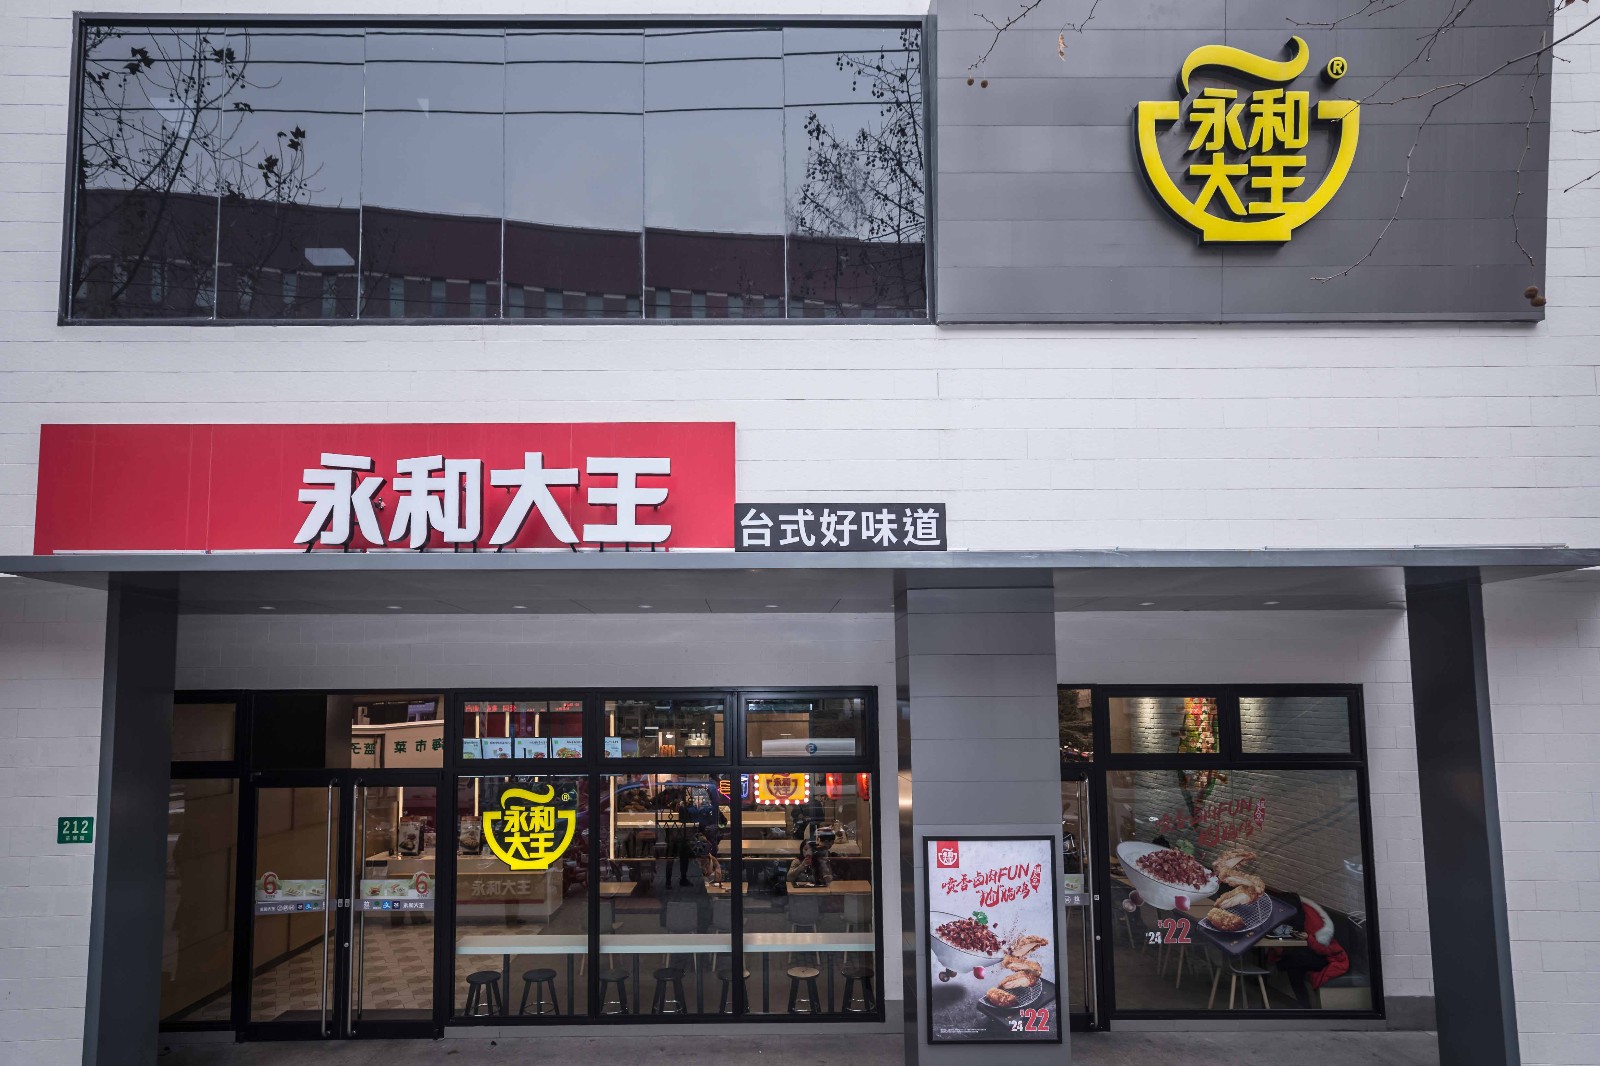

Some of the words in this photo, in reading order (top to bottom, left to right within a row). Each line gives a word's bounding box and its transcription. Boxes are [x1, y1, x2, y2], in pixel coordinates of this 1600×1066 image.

[1188, 87, 1310, 152] 永和
[1188, 152, 1307, 216] 大王
[293, 451, 672, 544] 永和大王
[739, 507, 942, 547] 台式好味道
[63, 820, 89, 834] 212
[503, 805, 555, 833] 永和
[504, 831, 555, 859] 大王
[471, 879, 532, 896] 永和大王
